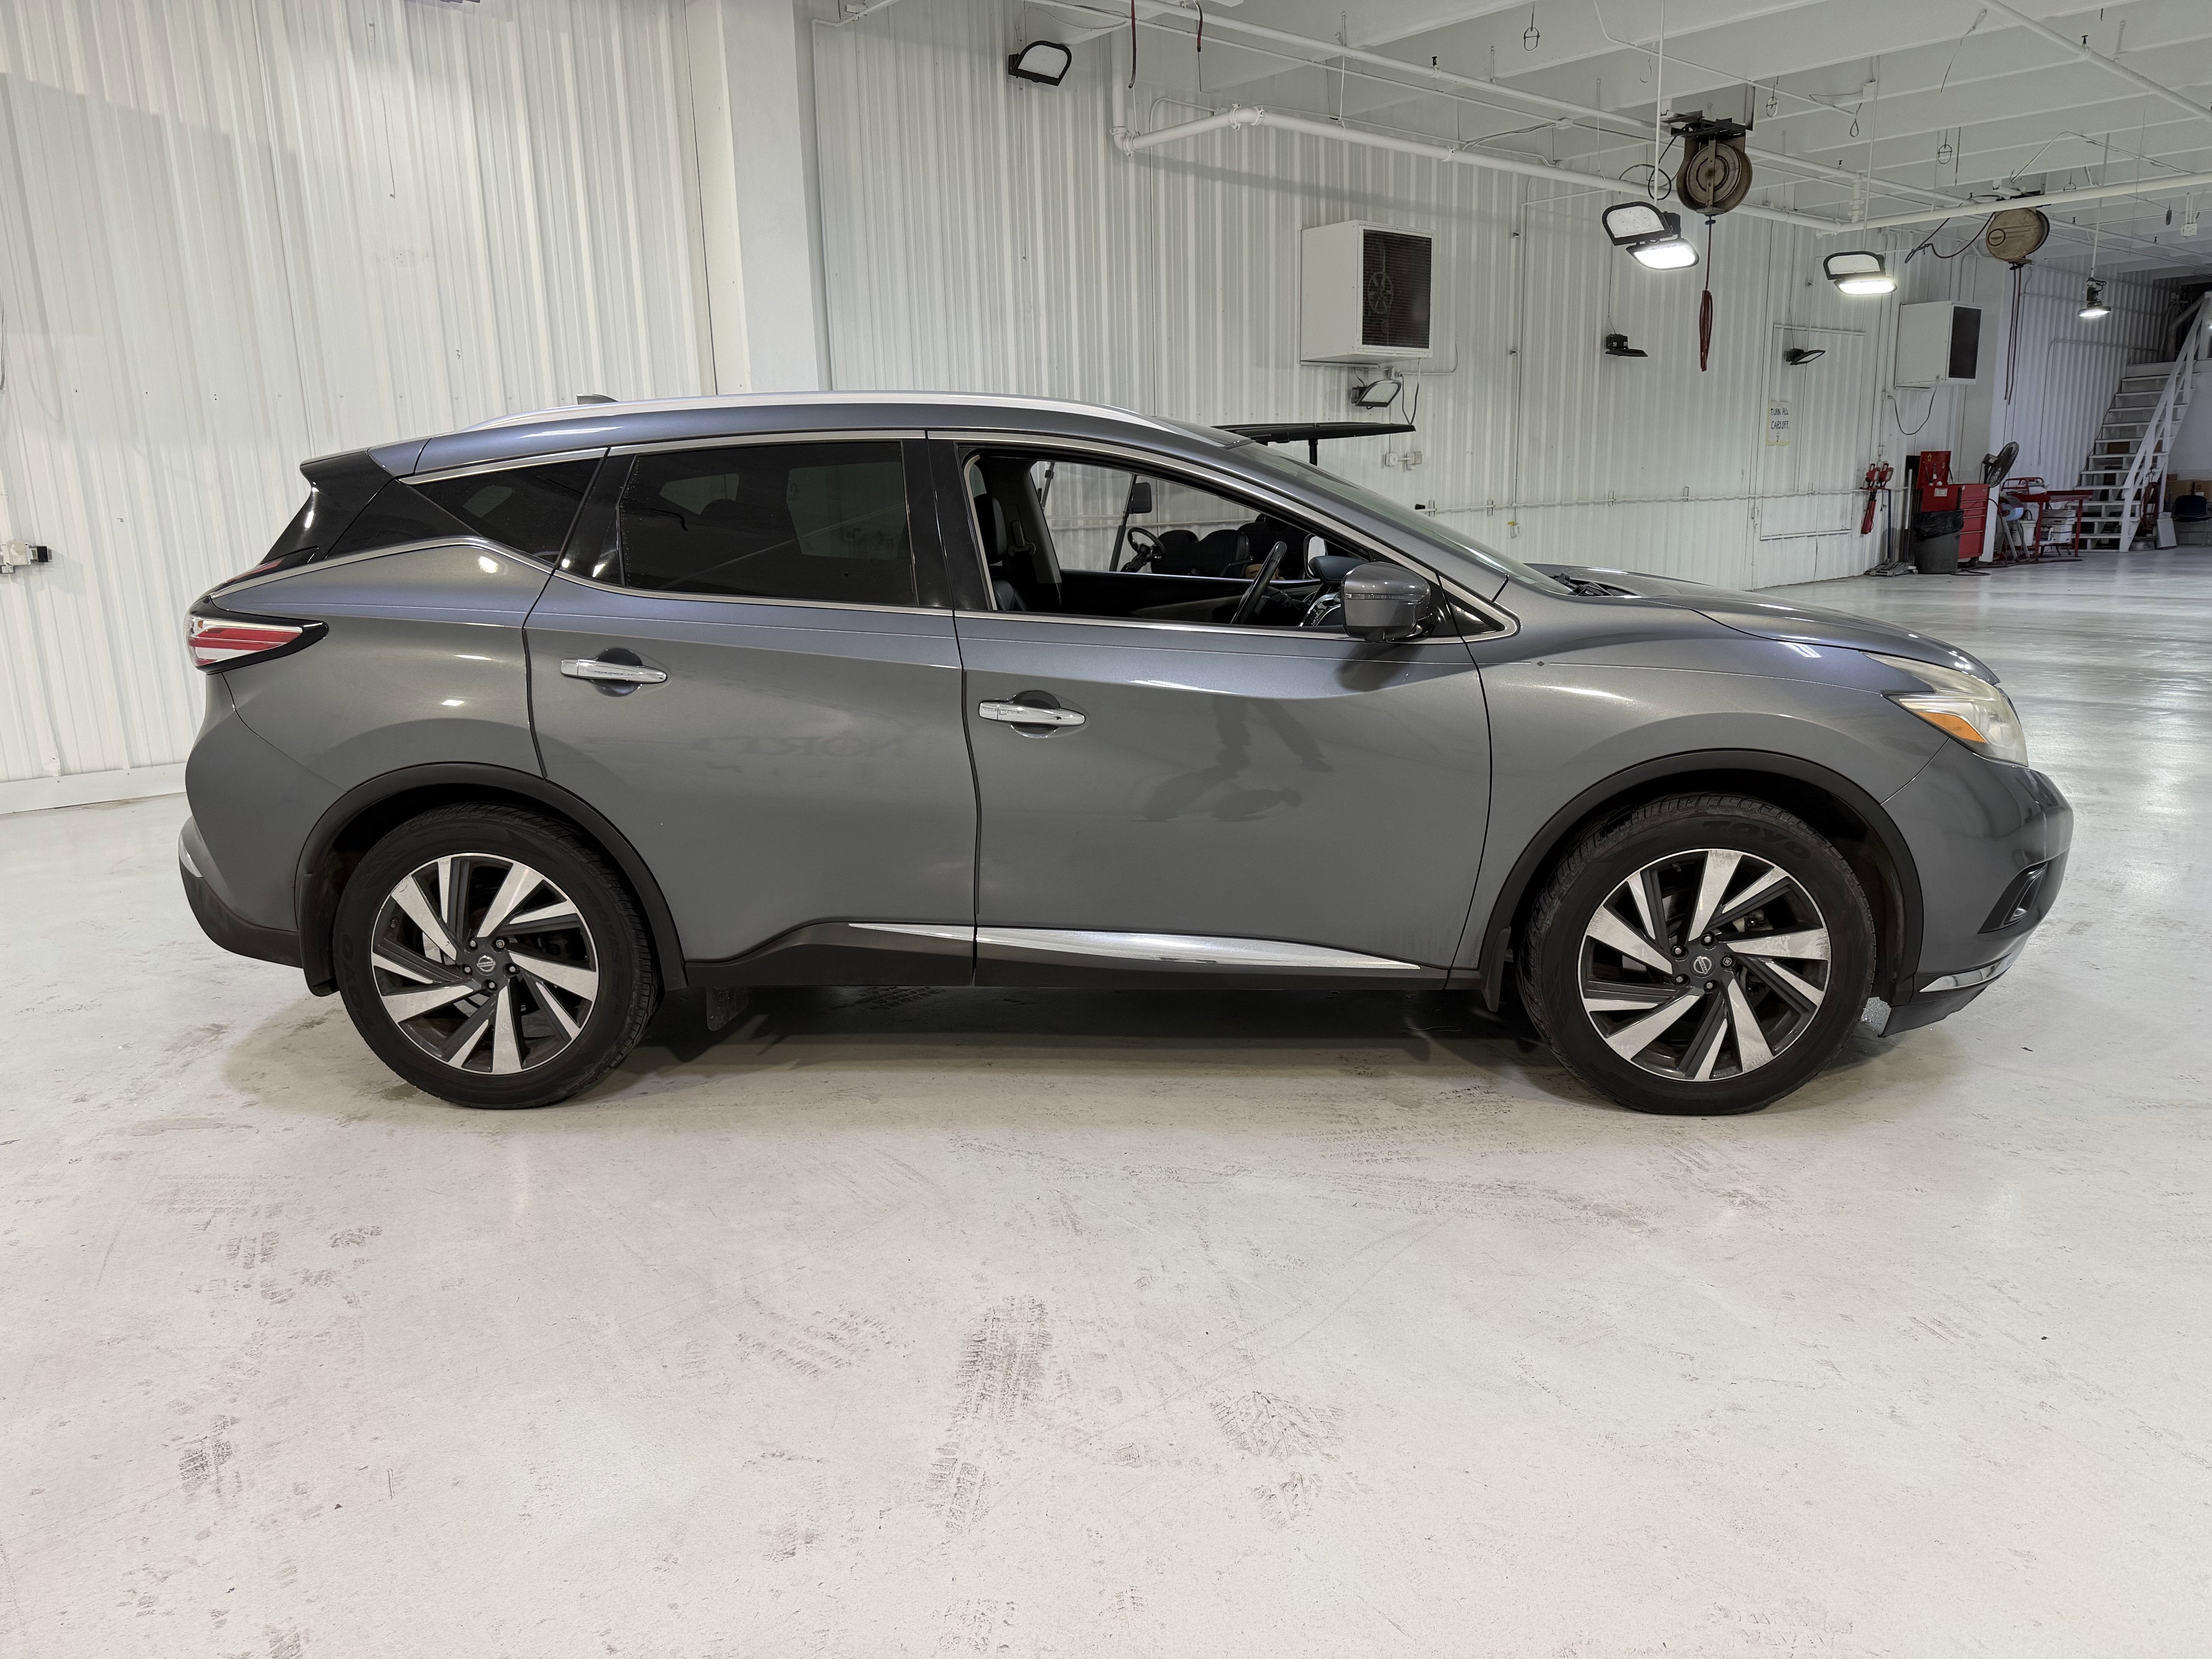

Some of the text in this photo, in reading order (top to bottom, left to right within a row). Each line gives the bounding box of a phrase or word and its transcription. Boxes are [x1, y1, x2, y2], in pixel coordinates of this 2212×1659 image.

[1771, 421, 1781, 429] CARS
[1702, 821, 1811, 859] TOYO
[1698, 958, 1708, 974] NISSAN
[342, 934, 376, 1033] TOYO
